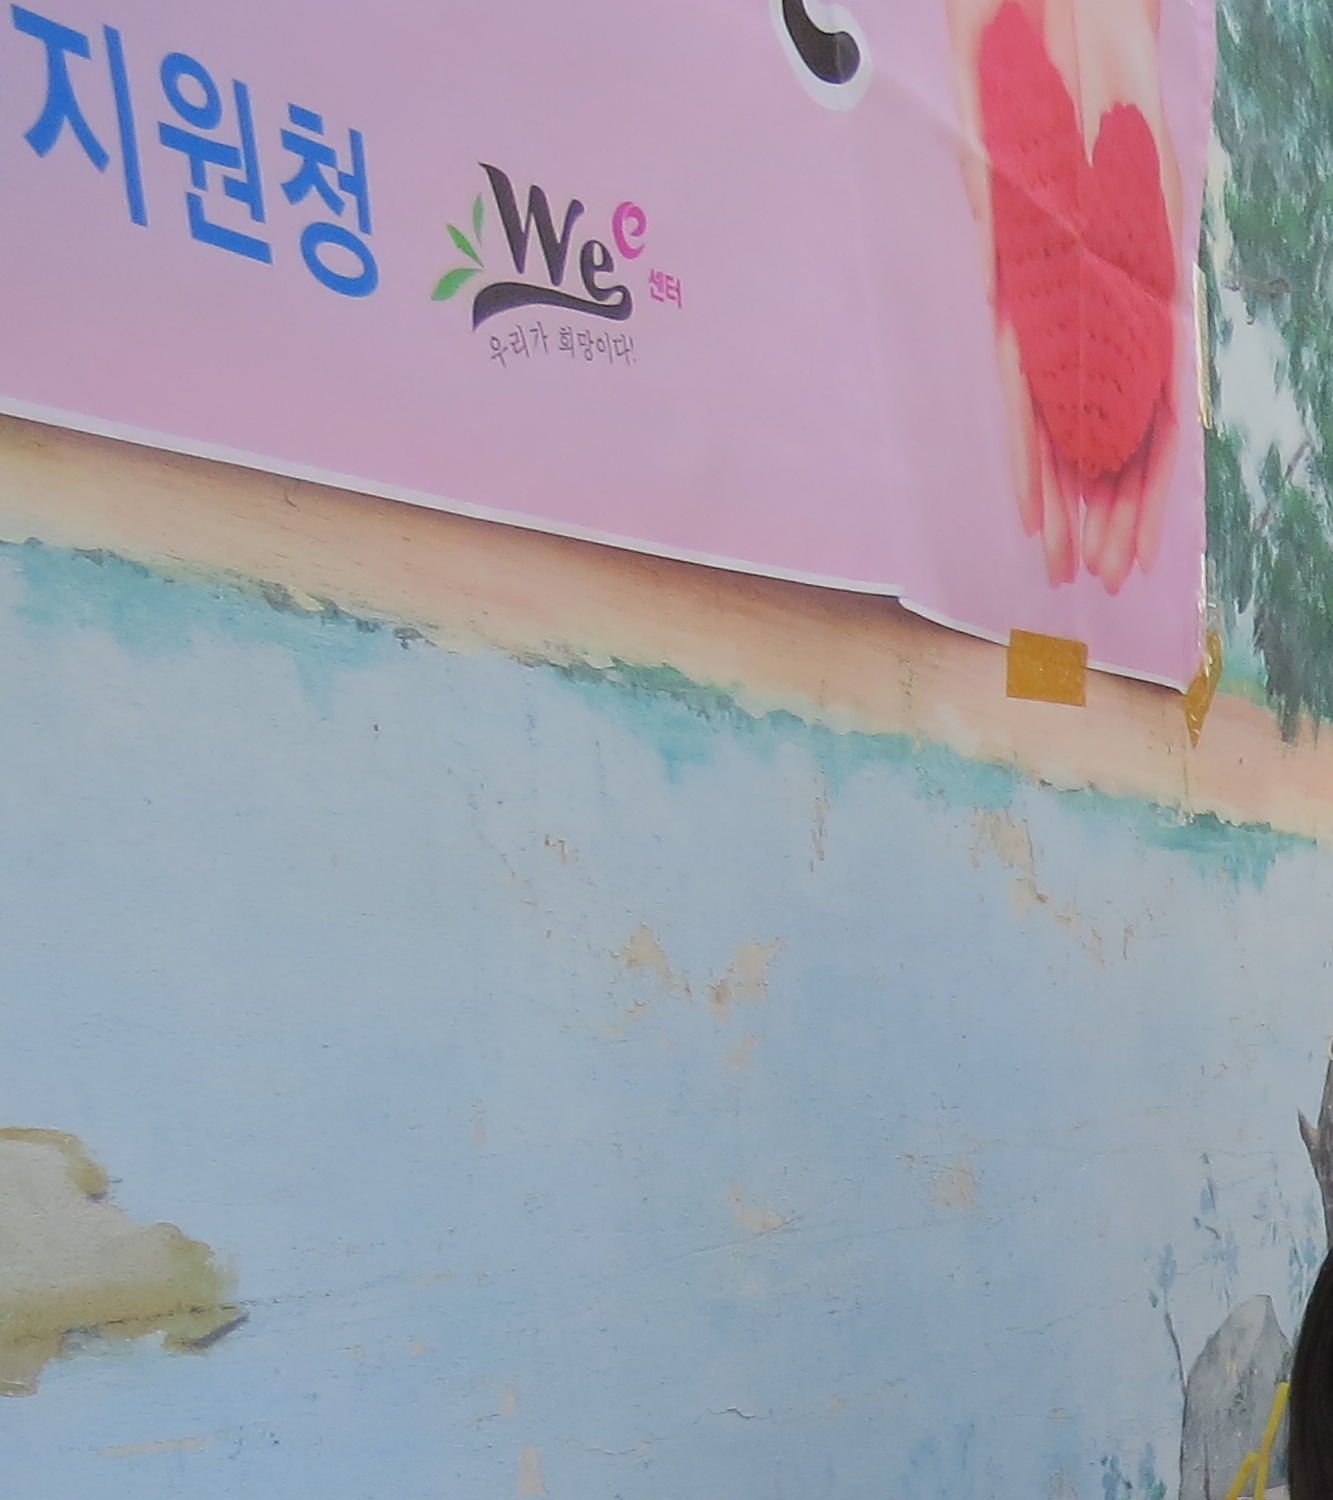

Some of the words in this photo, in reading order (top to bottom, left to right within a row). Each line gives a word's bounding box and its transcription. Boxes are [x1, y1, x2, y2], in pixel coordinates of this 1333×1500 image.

[10, 4, 379, 298] 지원청
[476, 162, 648, 316] Wee
[648, 269, 683, 308] 센터
[489, 321, 547, 368] 우리가
[558, 325, 637, 365] 희망이다!
